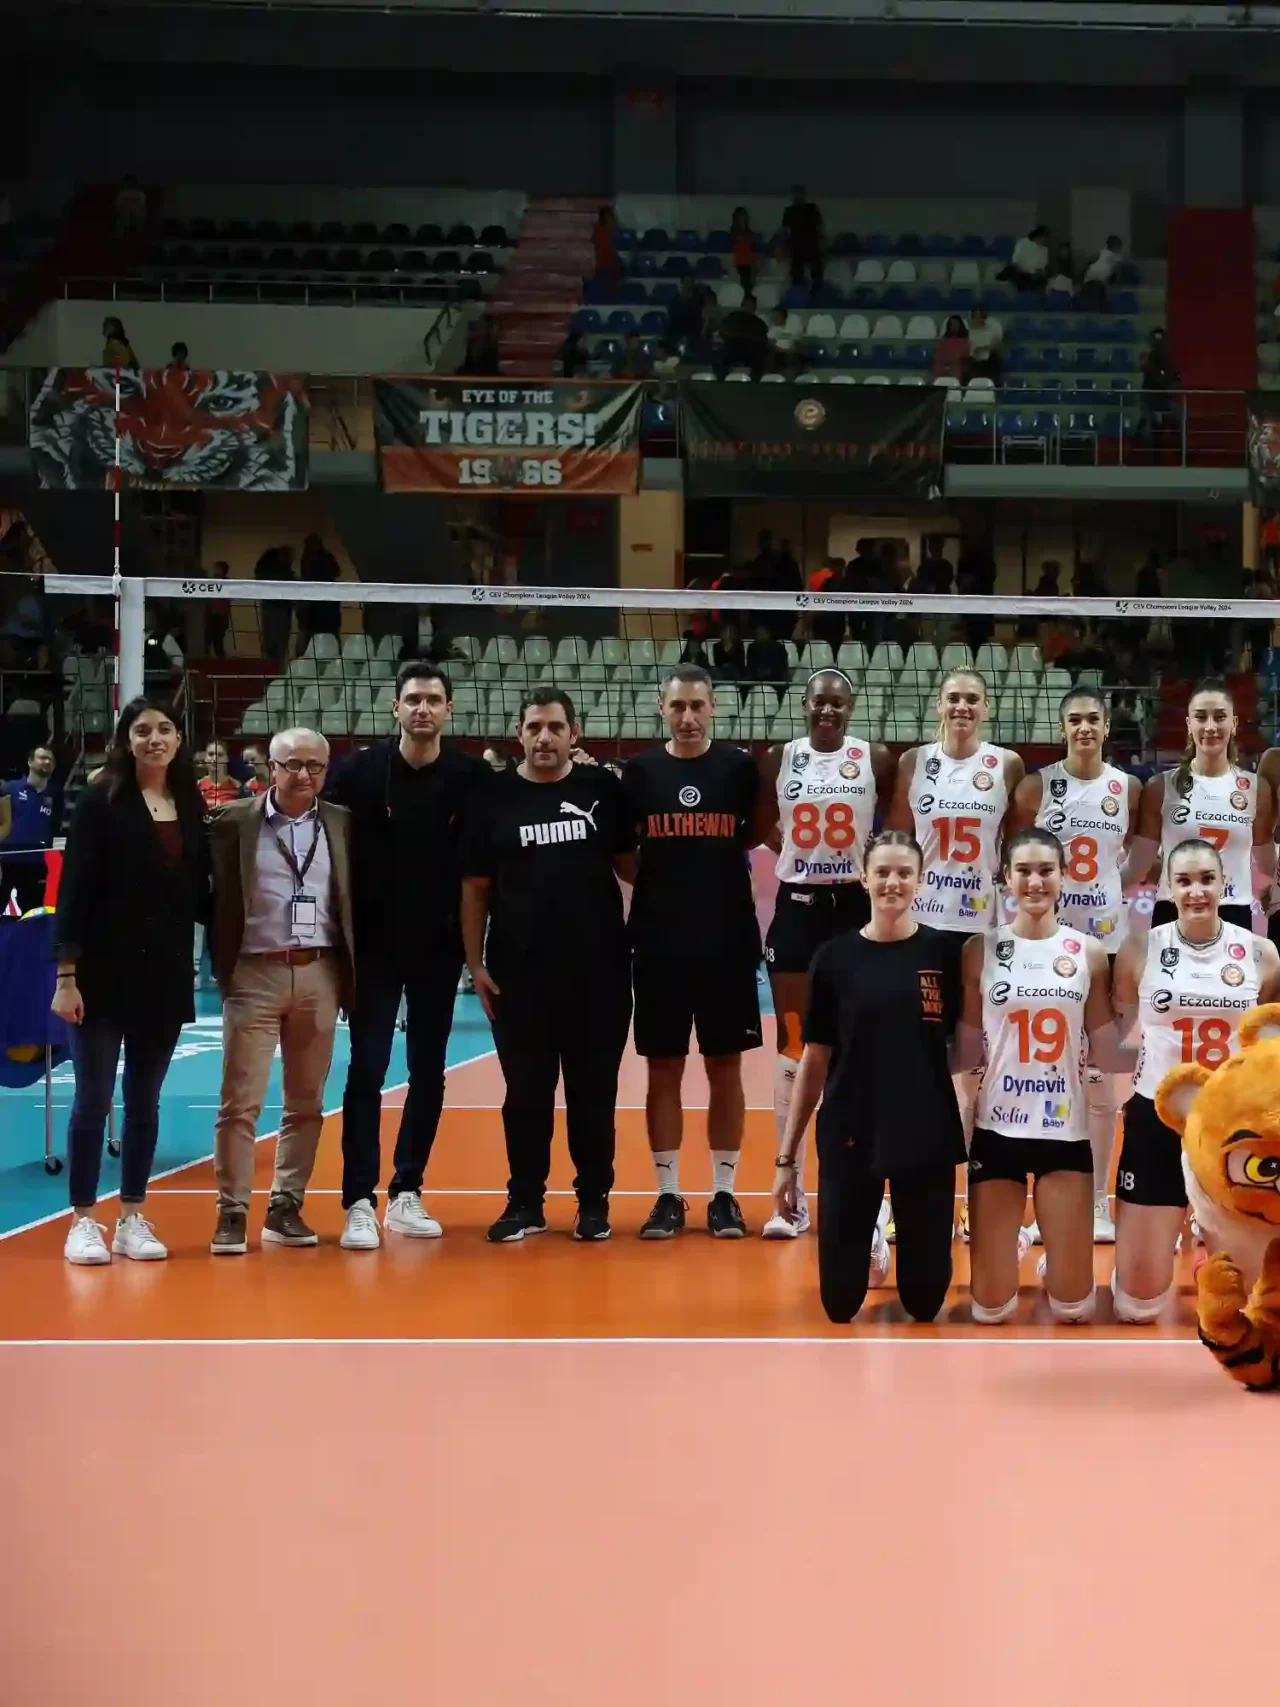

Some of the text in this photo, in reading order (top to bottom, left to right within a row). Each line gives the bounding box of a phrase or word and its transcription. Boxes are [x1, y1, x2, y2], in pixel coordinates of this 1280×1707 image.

[462, 389, 554, 404] EYE OF THE
[419, 410, 597, 446] TIGERS!
[198, 584, 223, 592] CEV
[502, 592, 535, 600] Champions
[826, 597, 858, 606] Champions
[858, 598, 880, 606] League
[1146, 603, 1178, 612] Champions
[1178, 604, 1199, 612] League
[791, 802, 855, 849] 88
[1195, 810, 1250, 826] Eczacıbaş
[519, 819, 587, 847] PUMA
[932, 817, 981, 863] 15
[795, 858, 852, 876] Dynavit
[1068, 836, 1098, 882] 8
[927, 870, 981, 890] Dynavit
[911, 897, 944, 914] Selin
[1058, 891, 1107, 908] ynavit
[1008, 1007, 1066, 1064] 19
[1172, 1017, 1231, 1071] 18
[1003, 1075, 1066, 1096] Dynavit
[991, 1105, 1029, 1124] Selin
[1119, 1170, 1135, 1191] 18
